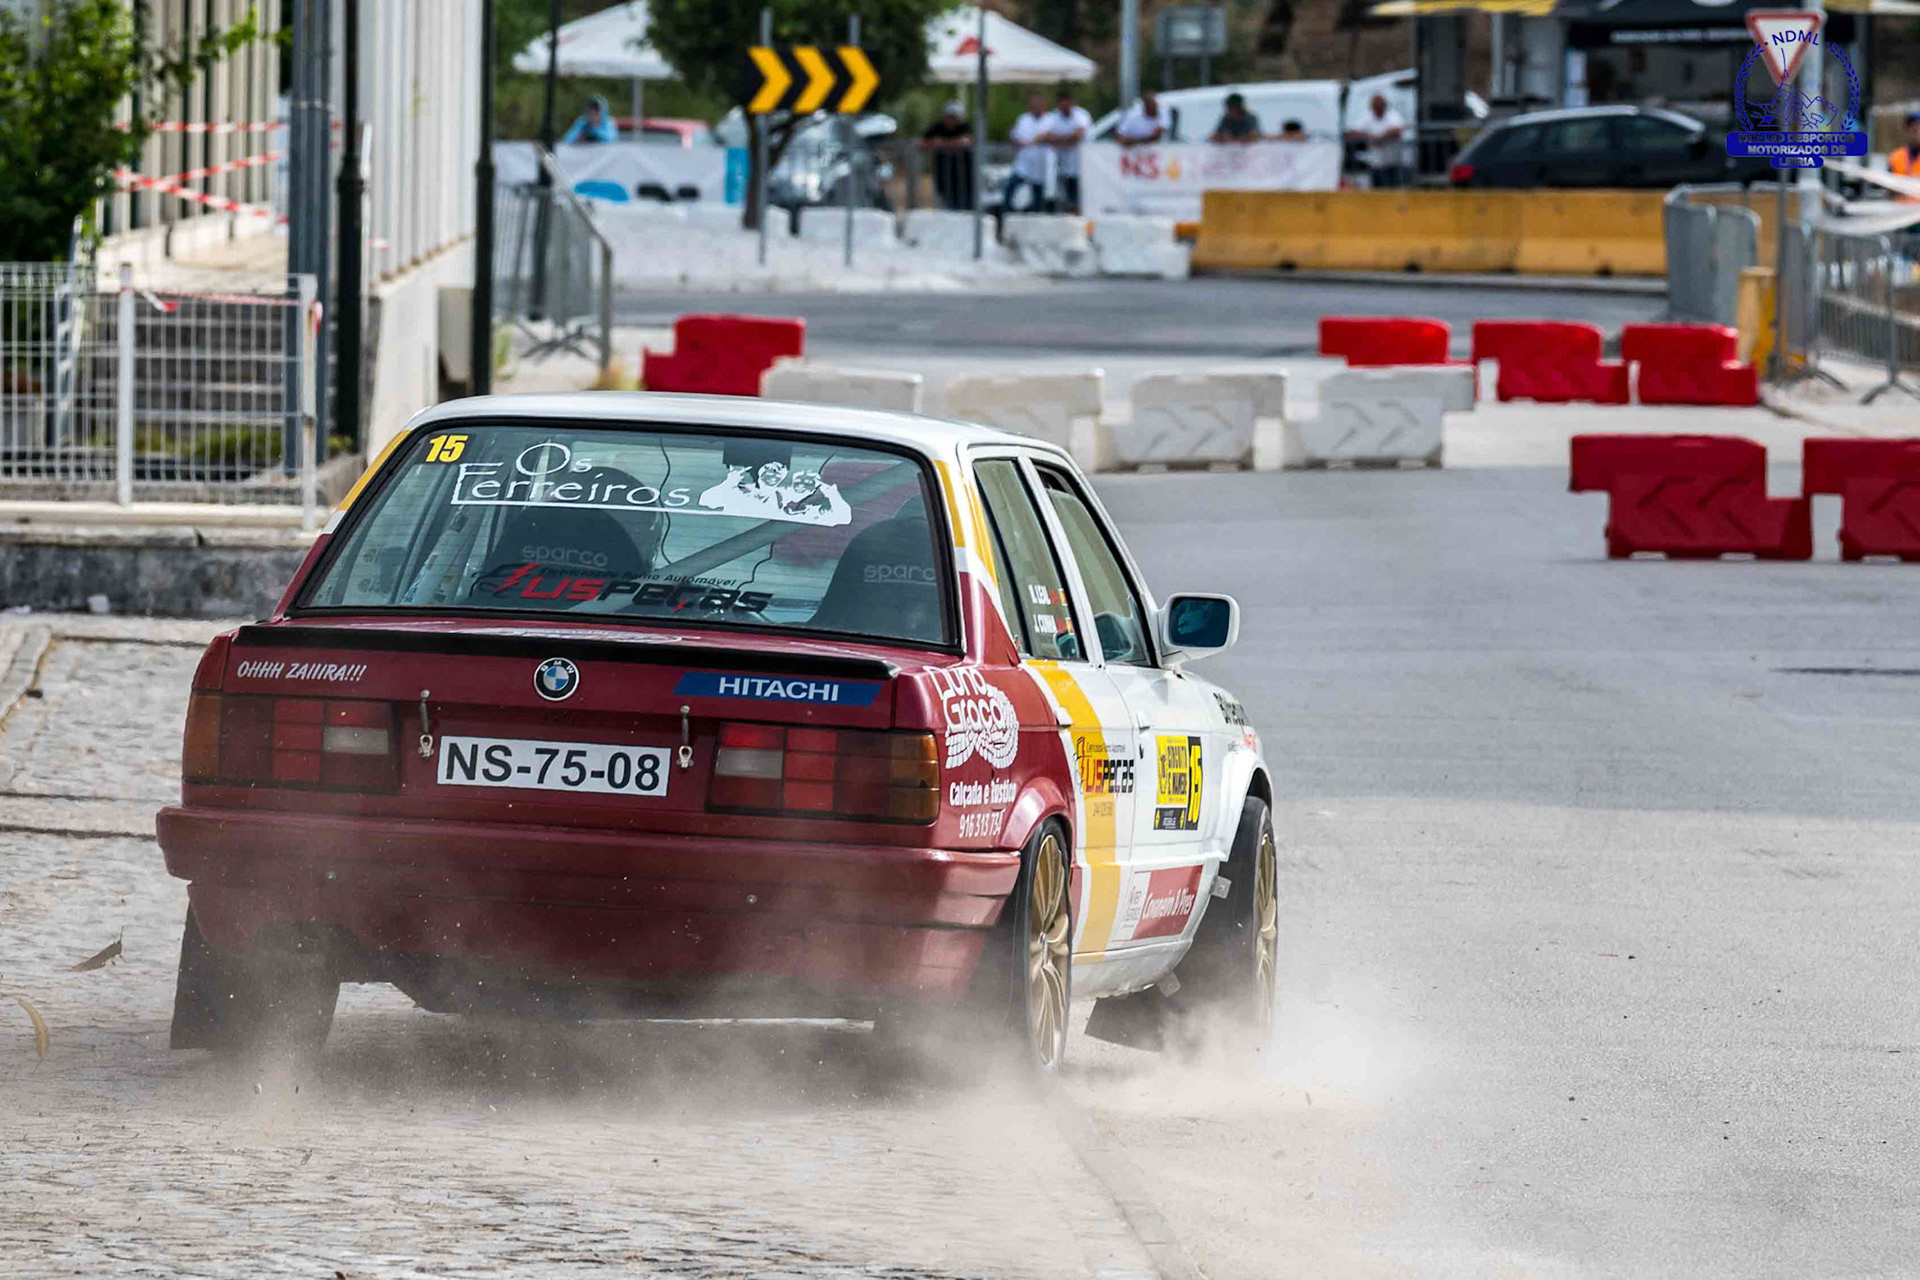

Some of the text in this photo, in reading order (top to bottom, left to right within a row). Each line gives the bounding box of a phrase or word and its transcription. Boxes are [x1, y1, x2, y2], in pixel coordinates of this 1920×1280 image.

[425, 434, 469, 462] 15
[515, 442, 593, 476] Os
[451, 462, 692, 508] Ferreiros
[522, 544, 609, 567] sparco
[664, 573, 738, 587] Automóvel
[237, 660, 368, 682] OHHH ZAIIIRA!!!
[718, 676, 840, 702] HITACHI
[444, 742, 661, 793] NS-75-08
[949, 780, 983, 808] Calçada
[983, 784, 990, 805] e
[959, 813, 975, 838] 916
